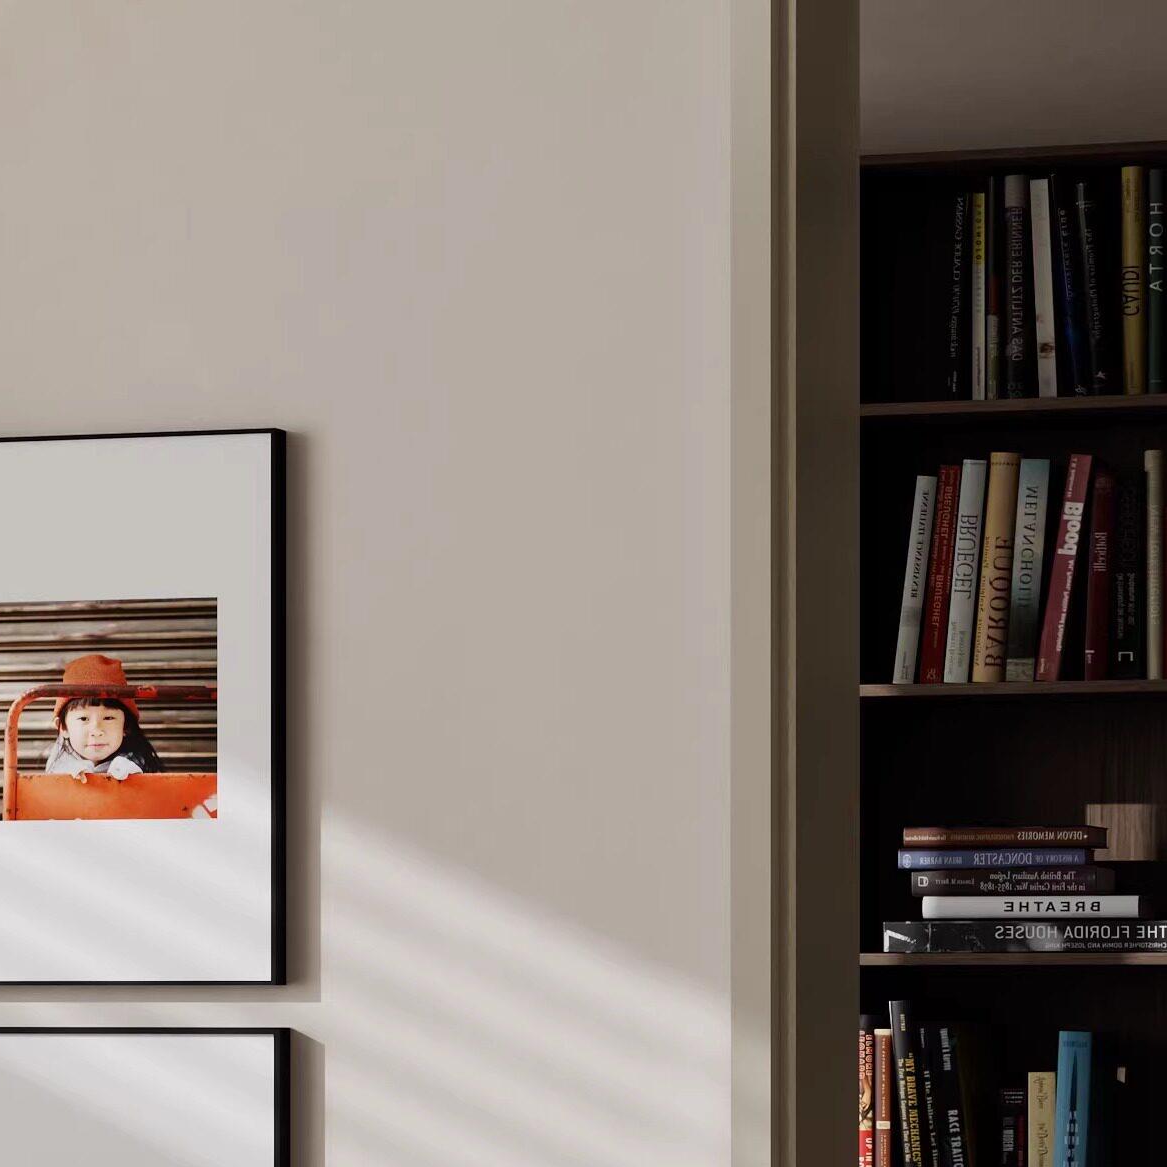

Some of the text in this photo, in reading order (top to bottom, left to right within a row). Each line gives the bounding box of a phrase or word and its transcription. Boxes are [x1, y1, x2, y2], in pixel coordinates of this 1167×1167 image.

[906, 1075, 918, 1107] BRAVE
[947, 1108, 961, 1133] RACE
[865, 1137, 873, 1149] UP
[865, 1152, 873, 1162] IN
